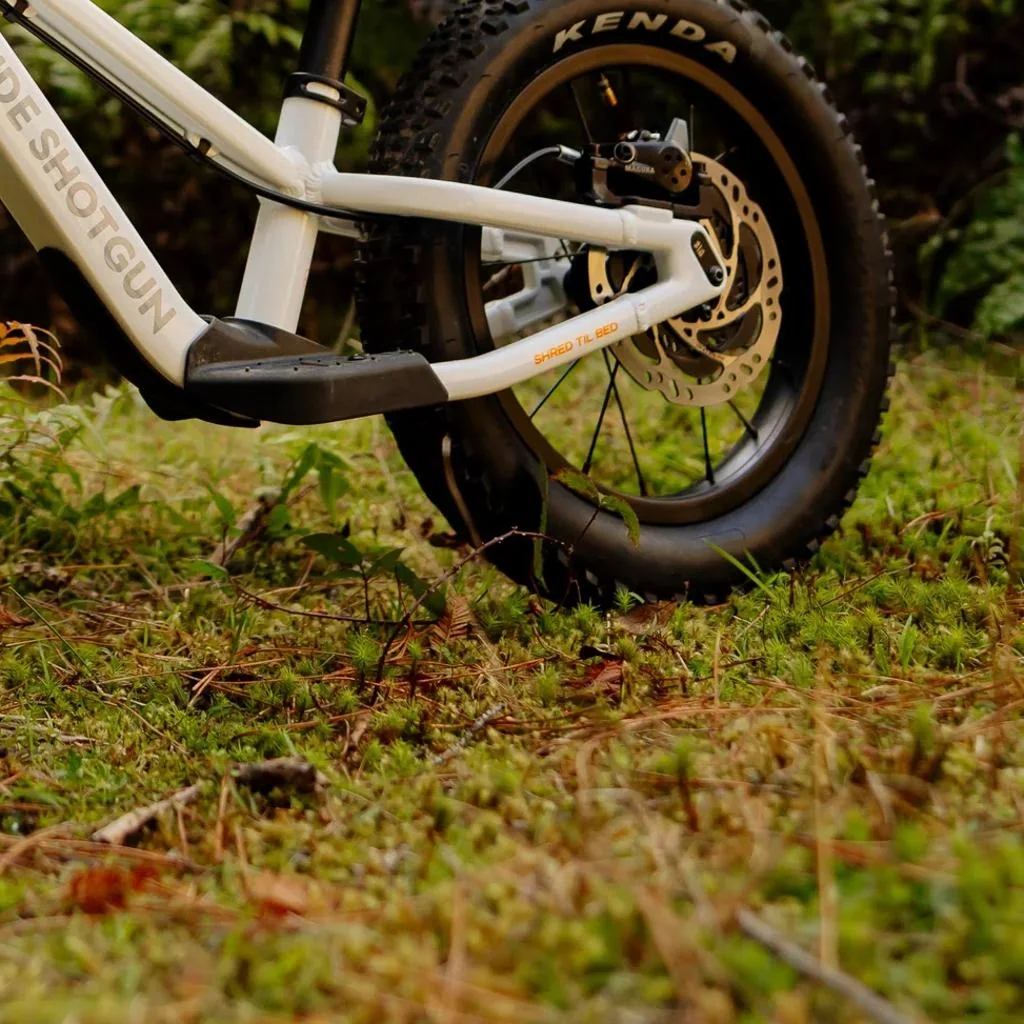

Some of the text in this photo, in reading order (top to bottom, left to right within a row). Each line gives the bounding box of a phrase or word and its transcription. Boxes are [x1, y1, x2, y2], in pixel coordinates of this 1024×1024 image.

[552, 11, 737, 64] KENDA
[28, 126, 177, 335] SHOTGUN
[534, 322, 618, 365] SHRED TIL BED
